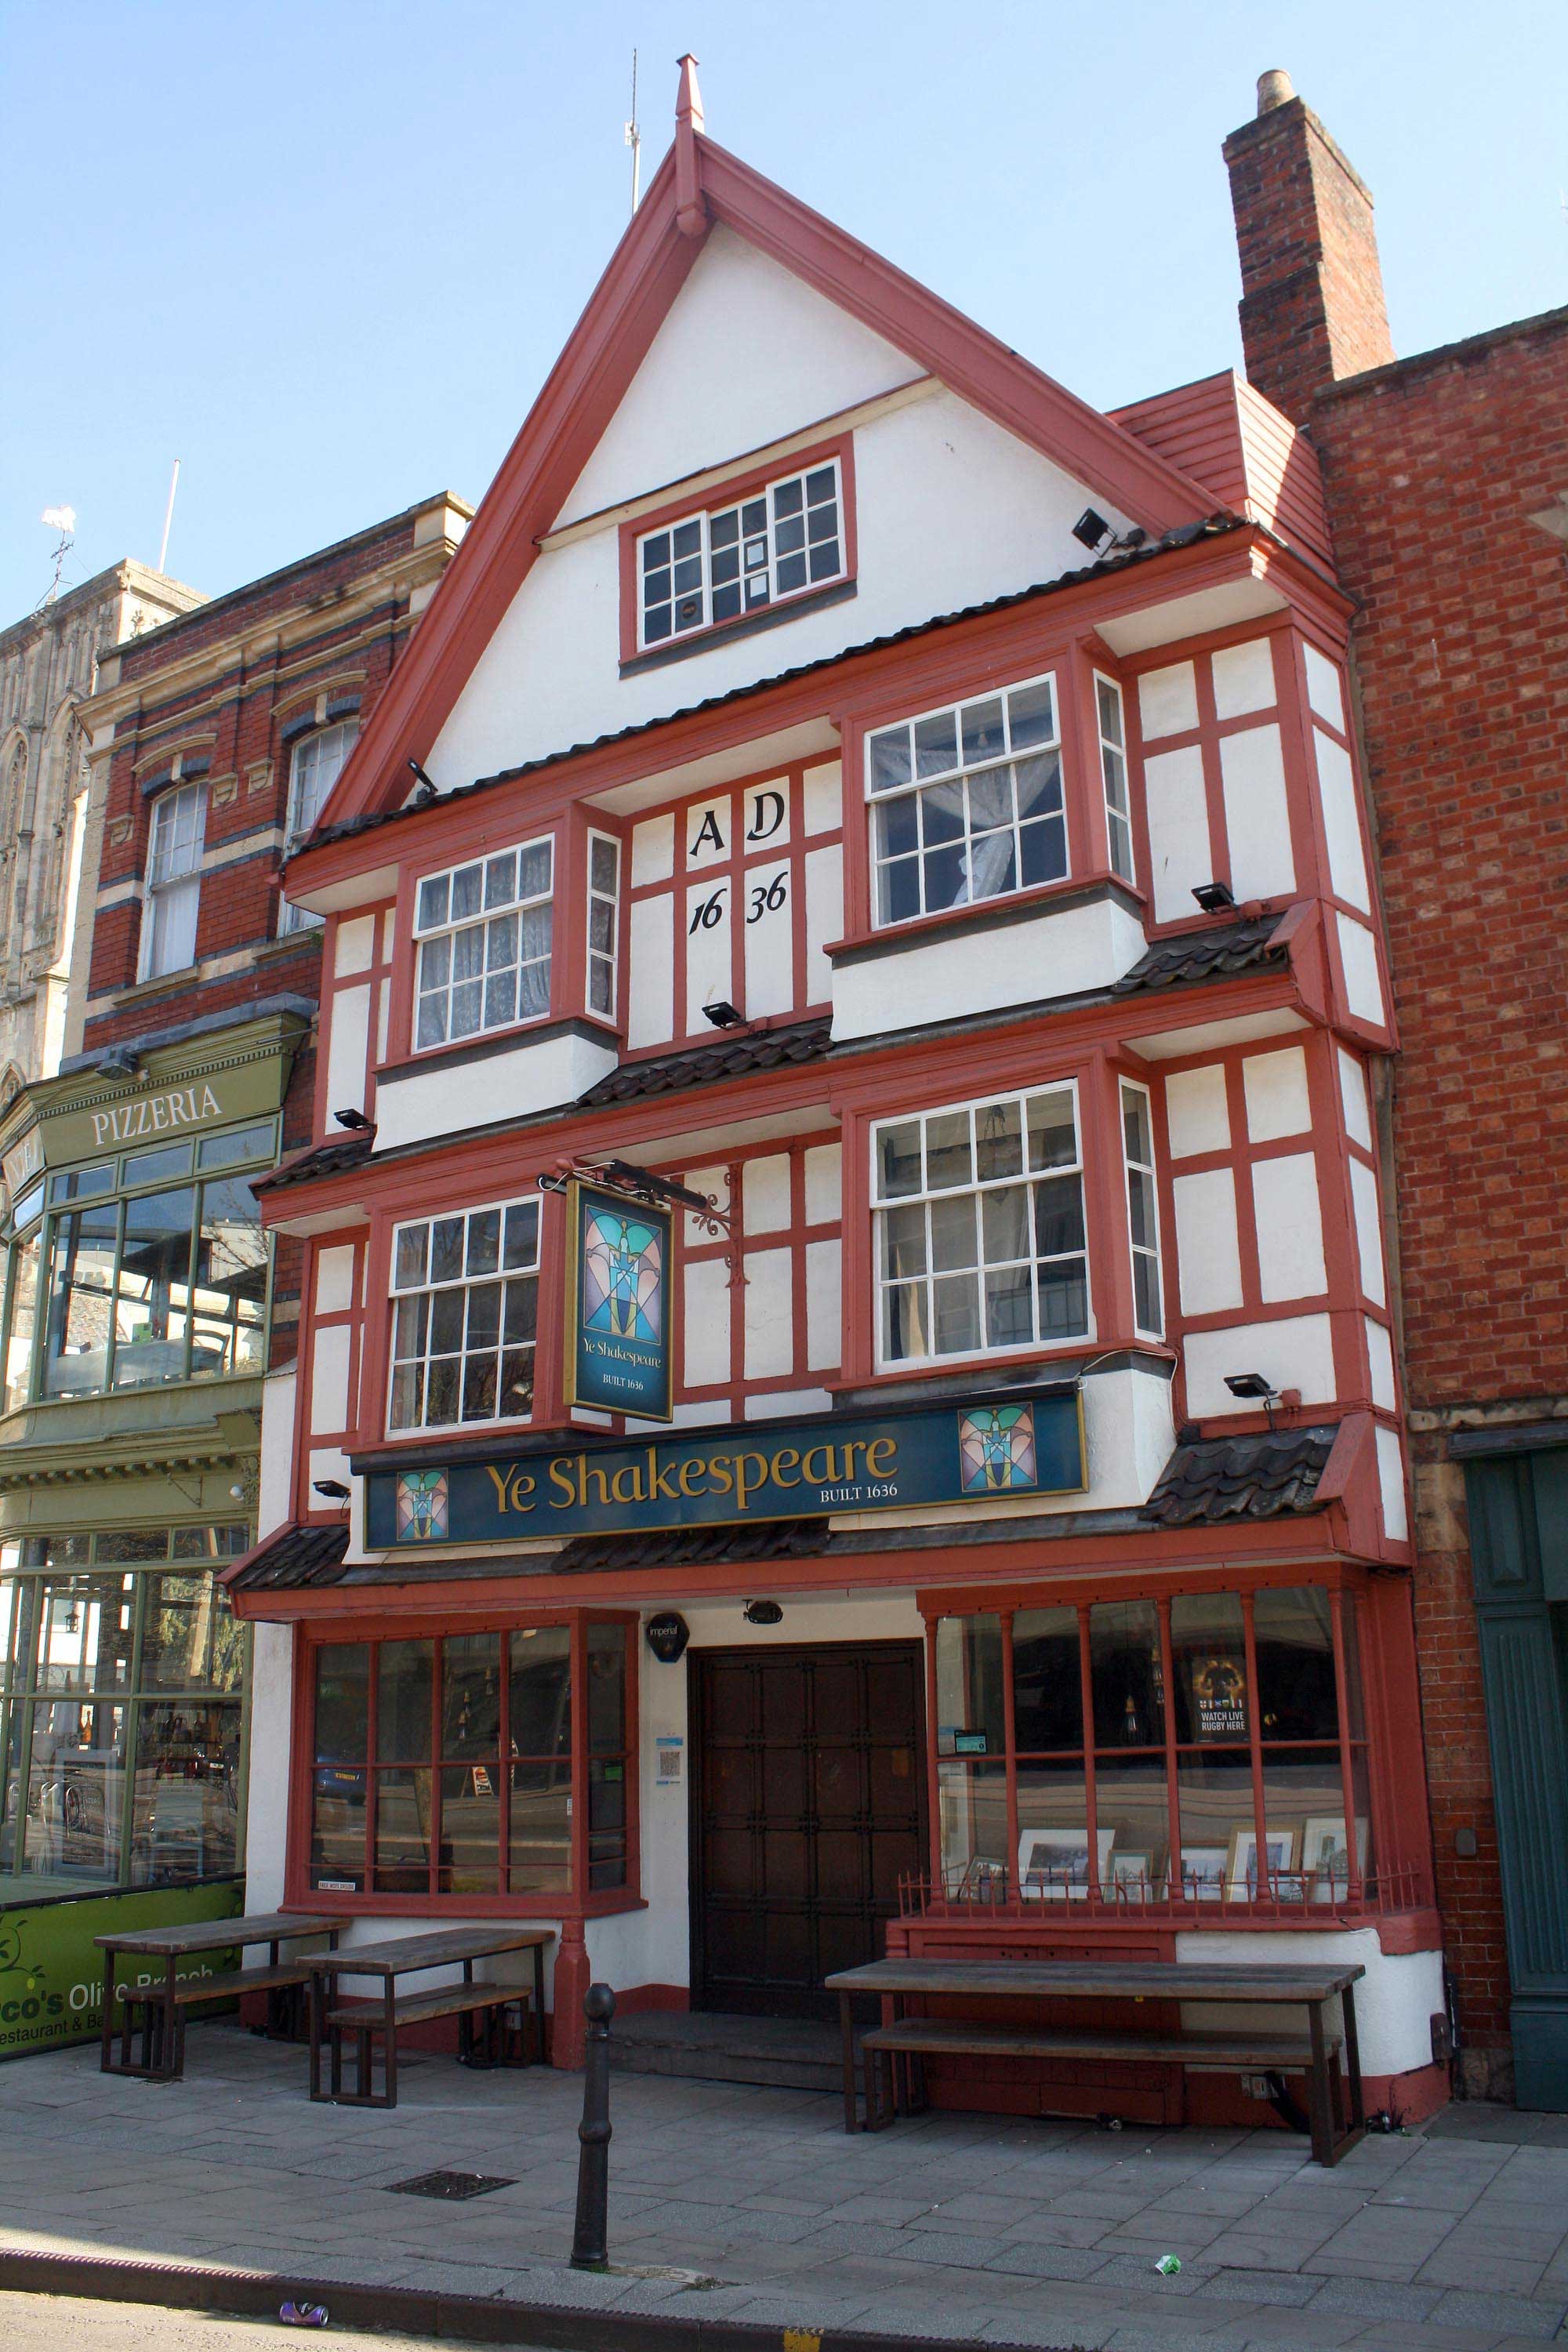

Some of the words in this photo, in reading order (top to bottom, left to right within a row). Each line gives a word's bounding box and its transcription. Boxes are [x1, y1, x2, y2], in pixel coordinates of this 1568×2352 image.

[689, 810, 724, 856] A
[746, 792, 785, 840] D
[689, 888, 728, 935] 16
[746, 872, 788, 924] 36
[91, 1085, 223, 1145] PIZZERIA
[583, 1338, 595, 1353] Ye
[597, 1341, 661, 1367] Shakespeare
[603, 1374, 626, 1387] BUILT
[627, 1380, 644, 1390] 1636
[485, 1463, 536, 1513] Ye
[548, 1437, 898, 1511] Shakespeare
[820, 1486, 862, 1503] BUILT
[866, 1483, 898, 1498] 1636
[650, 1625, 677, 1638] imperial
[1201, 1712, 1227, 1721] WATCH
[1229, 1711, 1244, 1720] LIVE
[1202, 1722, 1225, 1731] RUGBY
[1227, 1721, 1245, 1730] HERE
[0, 1990, 64, 2023] co's
[69, 1981, 129, 2010] Olie
[72, 2016, 82, 2031] &
[88, 2014, 104, 2029] Ba
